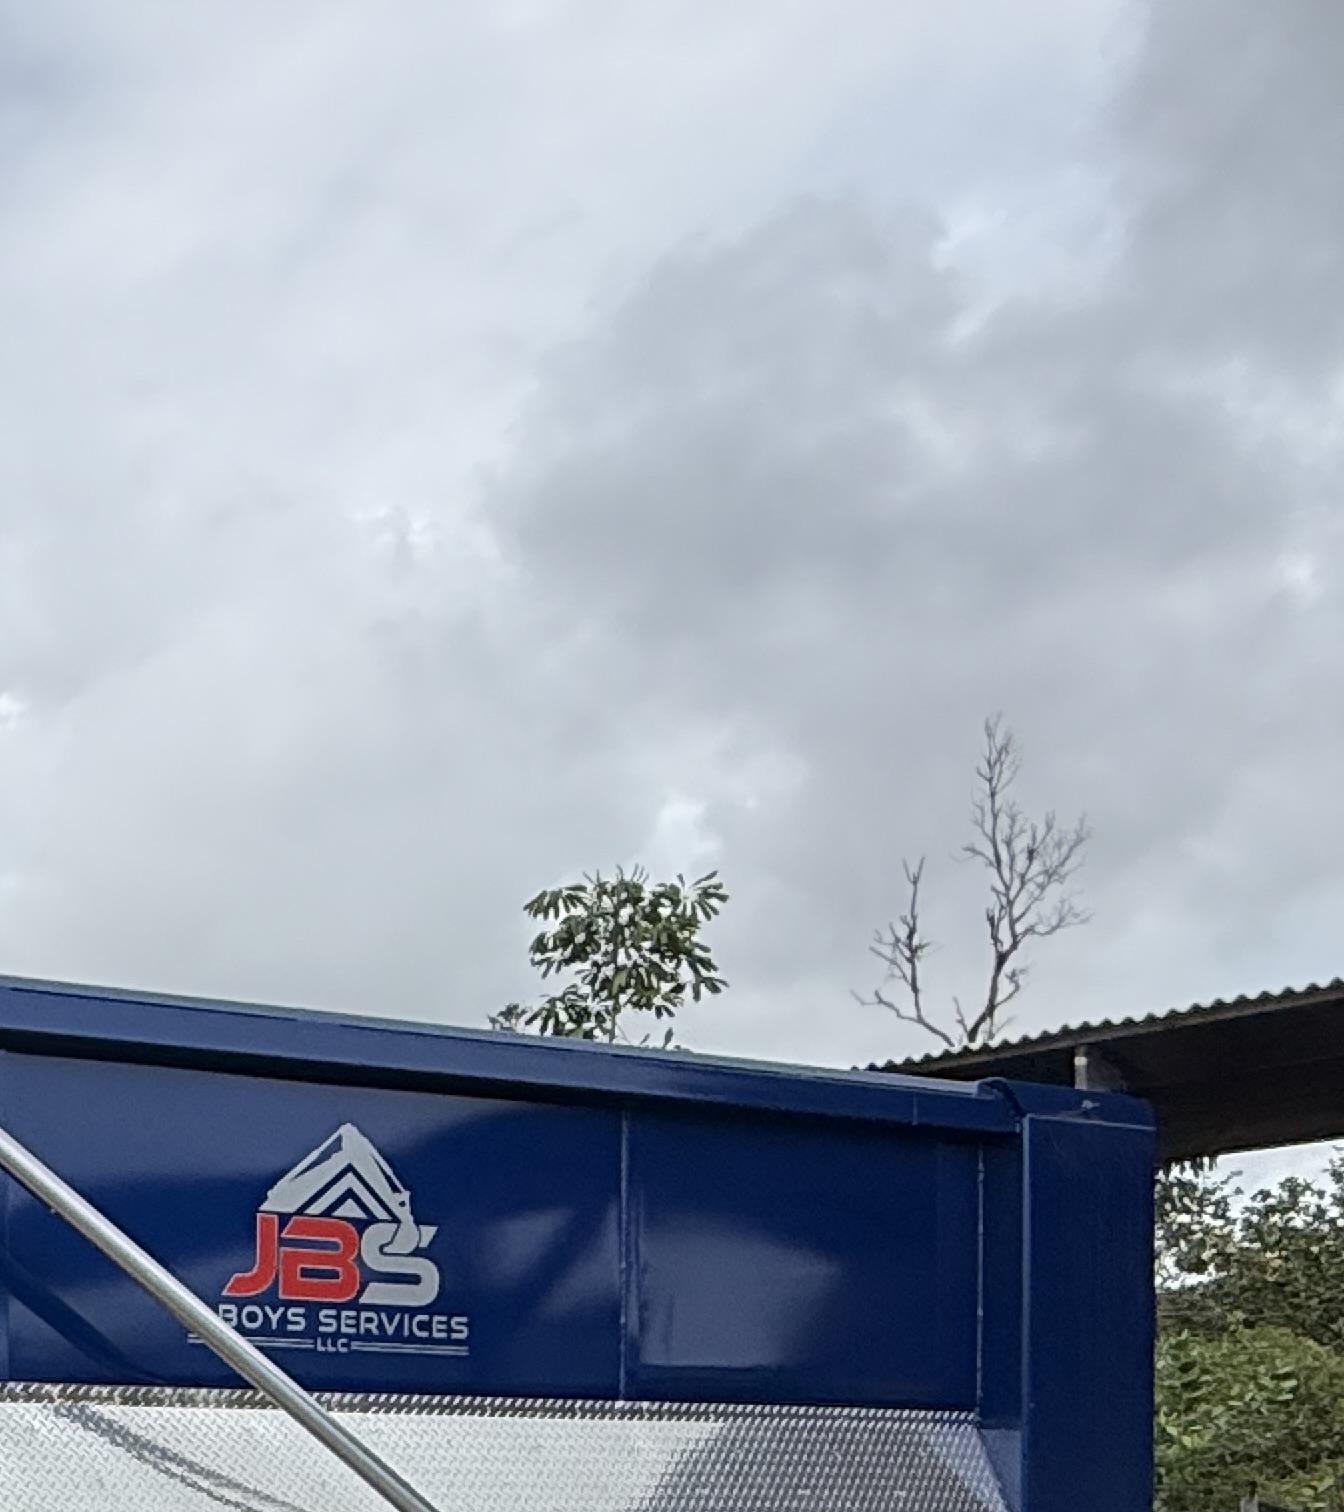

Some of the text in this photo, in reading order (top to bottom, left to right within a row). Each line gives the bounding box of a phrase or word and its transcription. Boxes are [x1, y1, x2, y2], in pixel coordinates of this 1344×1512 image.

[221, 1213, 440, 1307] JBS
[218, 1304, 470, 1340] BOYS SERVICES
[316, 1337, 349, 1353] LLC
